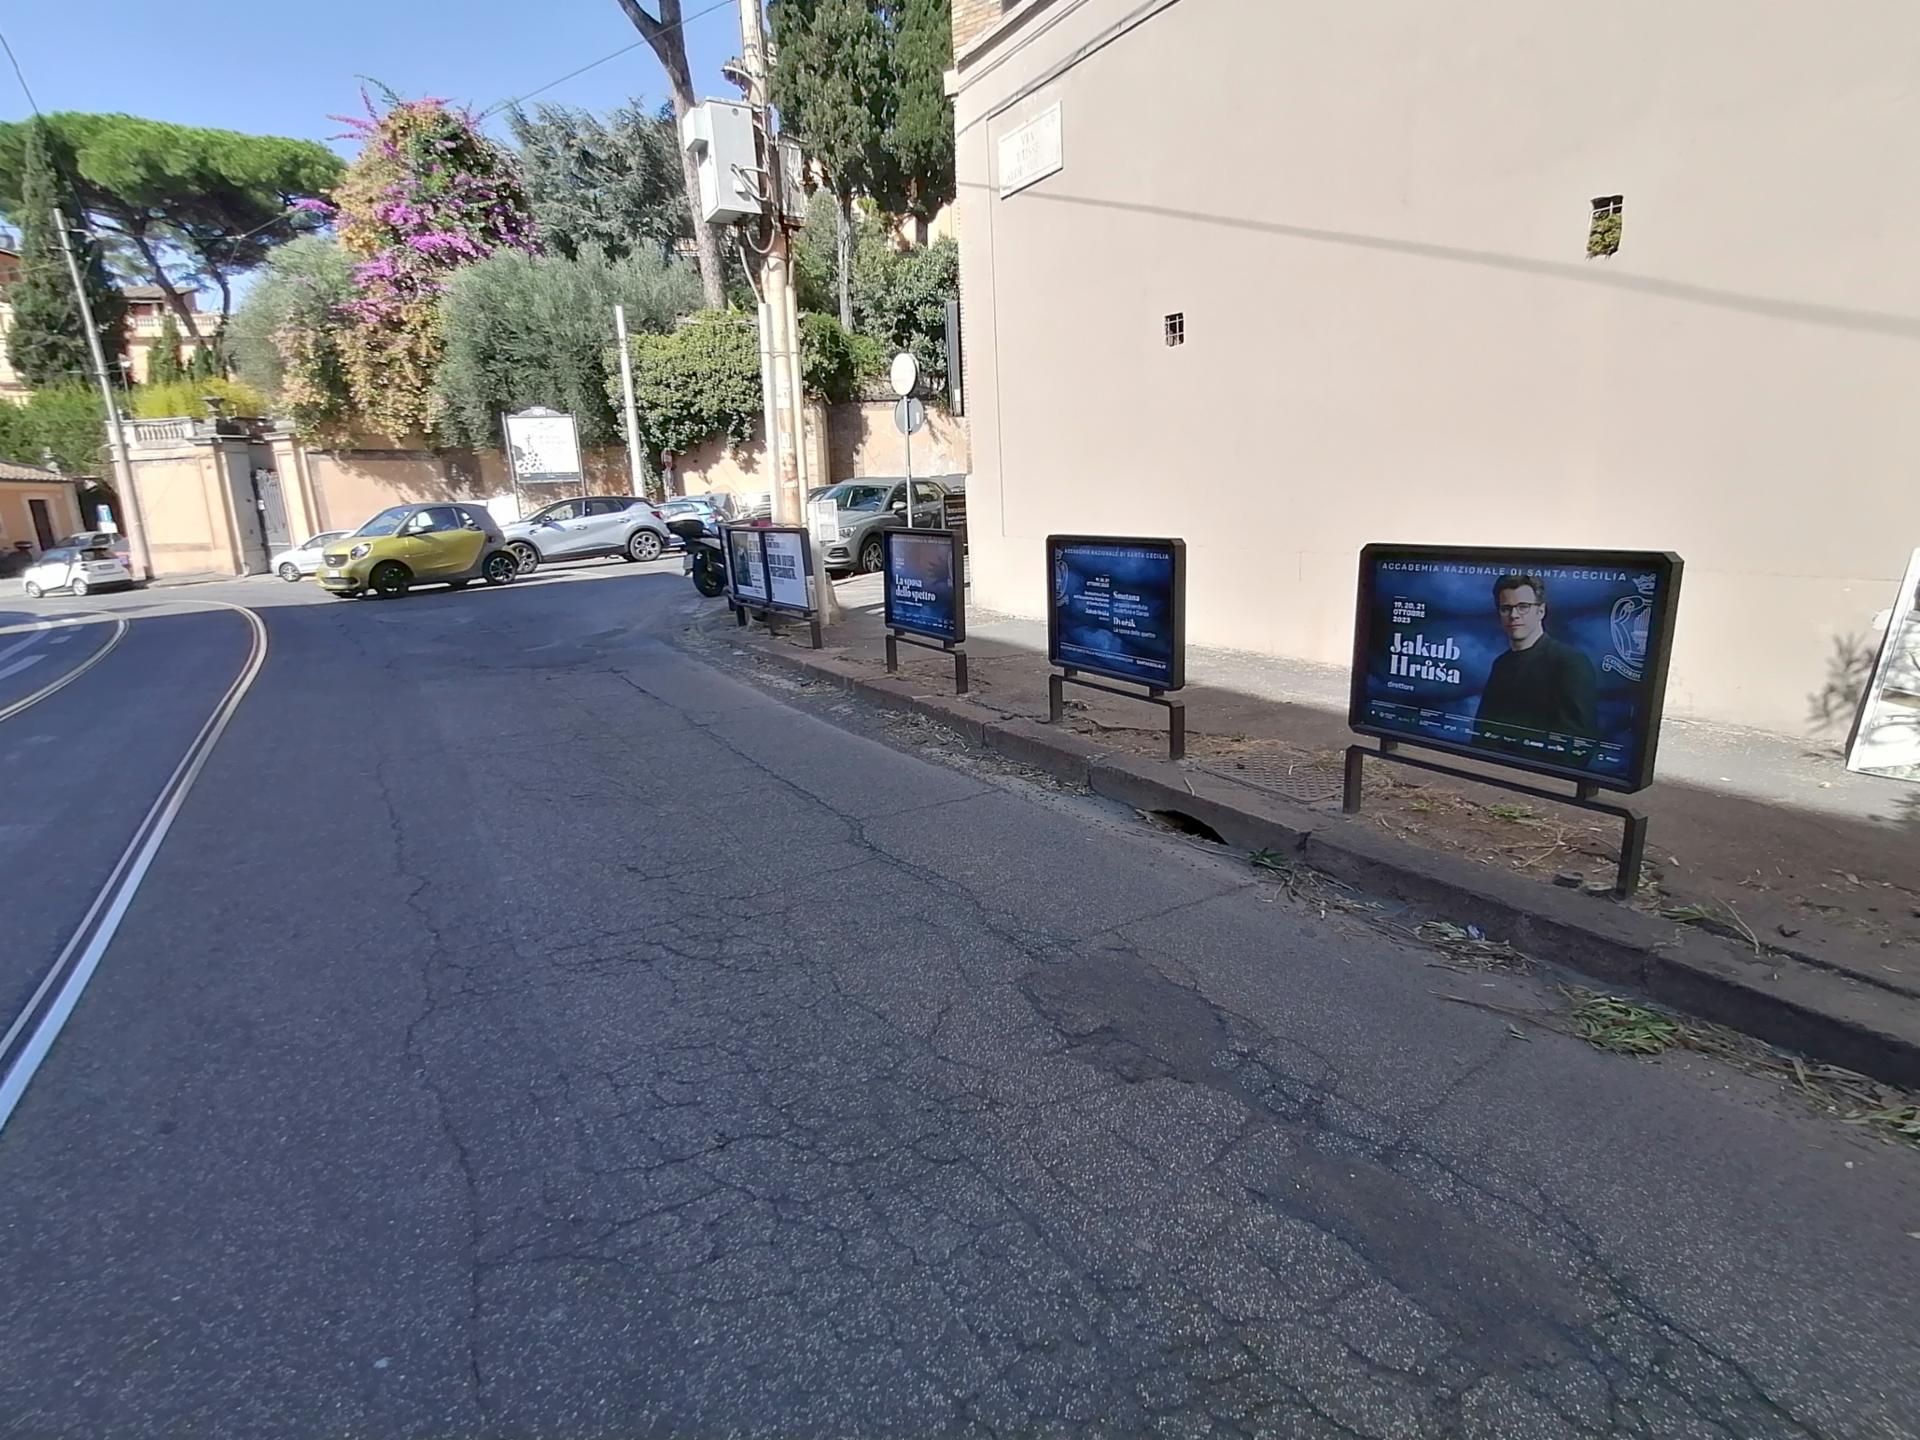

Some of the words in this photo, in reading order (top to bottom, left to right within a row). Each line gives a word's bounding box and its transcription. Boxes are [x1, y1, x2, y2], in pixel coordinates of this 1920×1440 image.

[1382, 562, 1439, 573] ACCADEMIA
[1443, 566, 1506, 576] NAZIONALE
[1510, 568, 1522, 577] DI
[1527, 568, 1568, 579] SANTA
[1572, 571, 1627, 582] CECILIA
[896, 574, 903, 585] La
[905, 579, 922, 589] sposa
[896, 585, 911, 597] dello
[912, 591, 935, 601] spettro
[1392, 616, 1411, 624] 2023
[1393, 609, 1425, 618] OTTOBRE
[1390, 632, 1461, 661] Jakub
[1390, 654, 1461, 684] Hrůša
[1387, 681, 1414, 692] direttore
